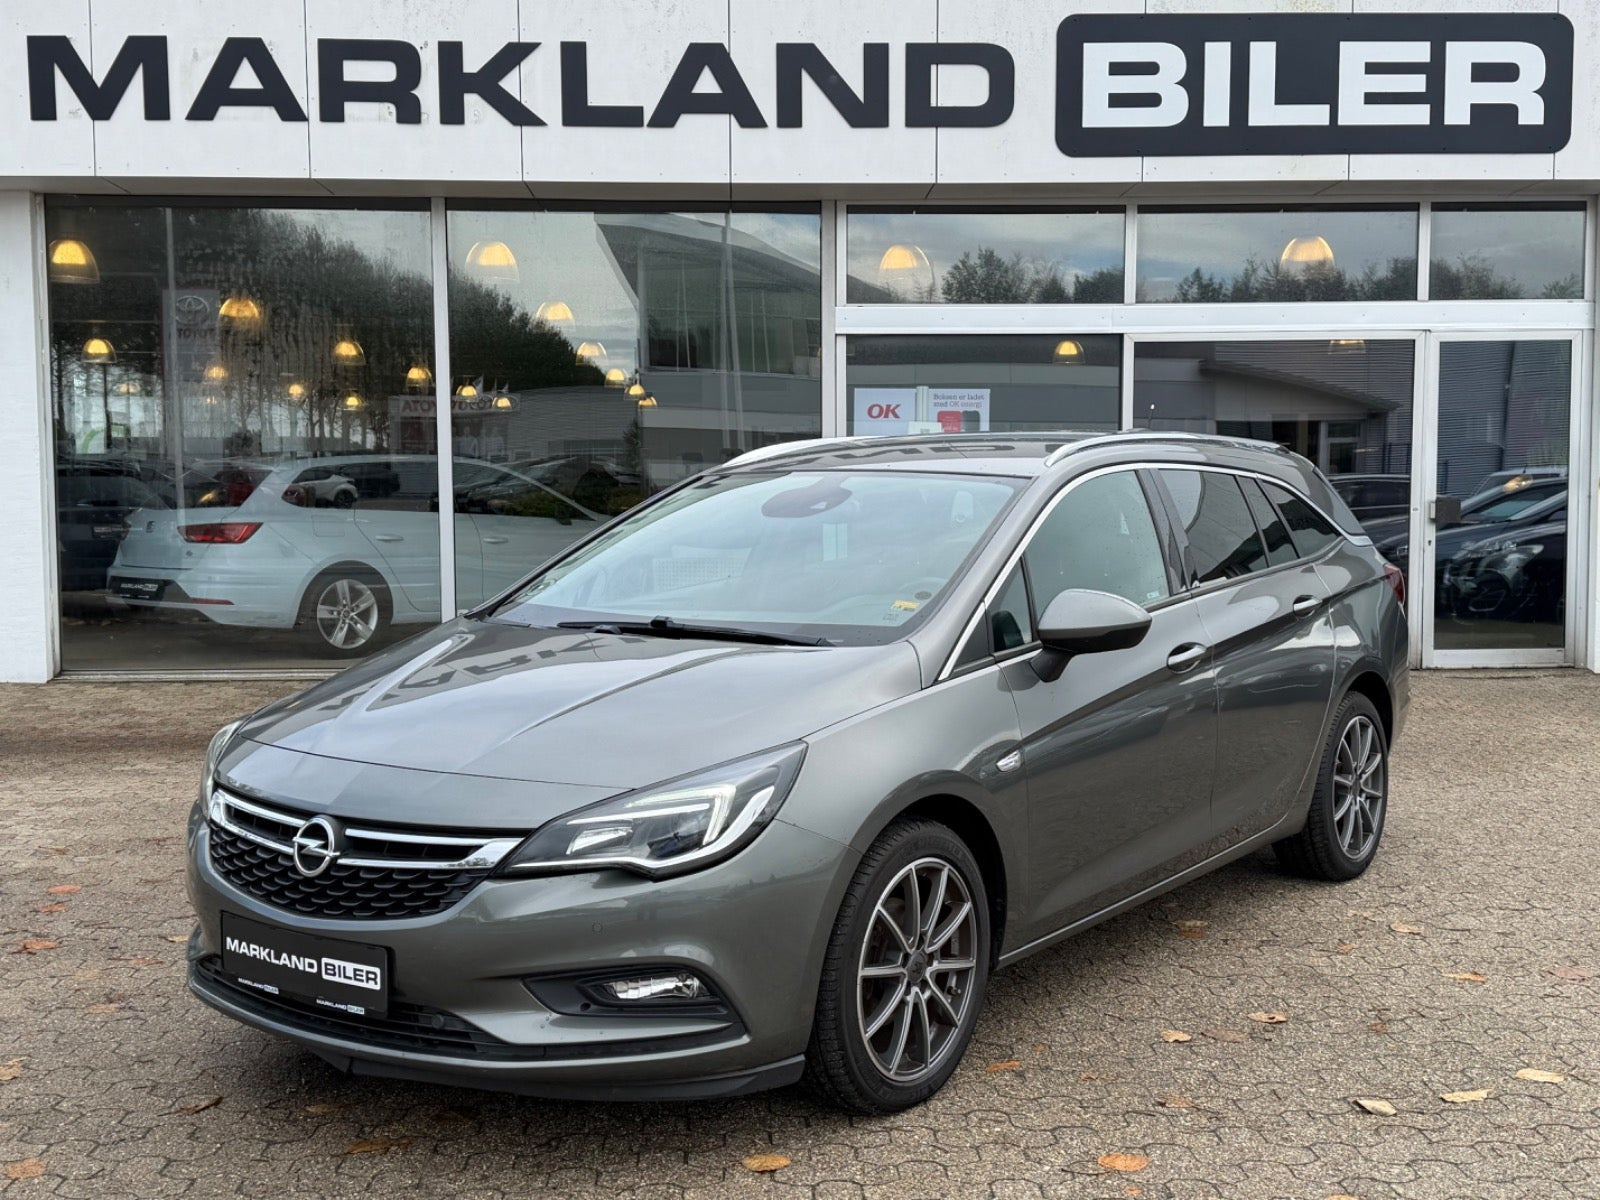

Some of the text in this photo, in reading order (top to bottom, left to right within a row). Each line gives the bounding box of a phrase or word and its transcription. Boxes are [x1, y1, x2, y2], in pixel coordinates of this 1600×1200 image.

[27, 35, 1546, 129] MARKLAND BILER
[867, 403, 901, 419] OK
[226, 936, 379, 986] MARKLAND BILER
